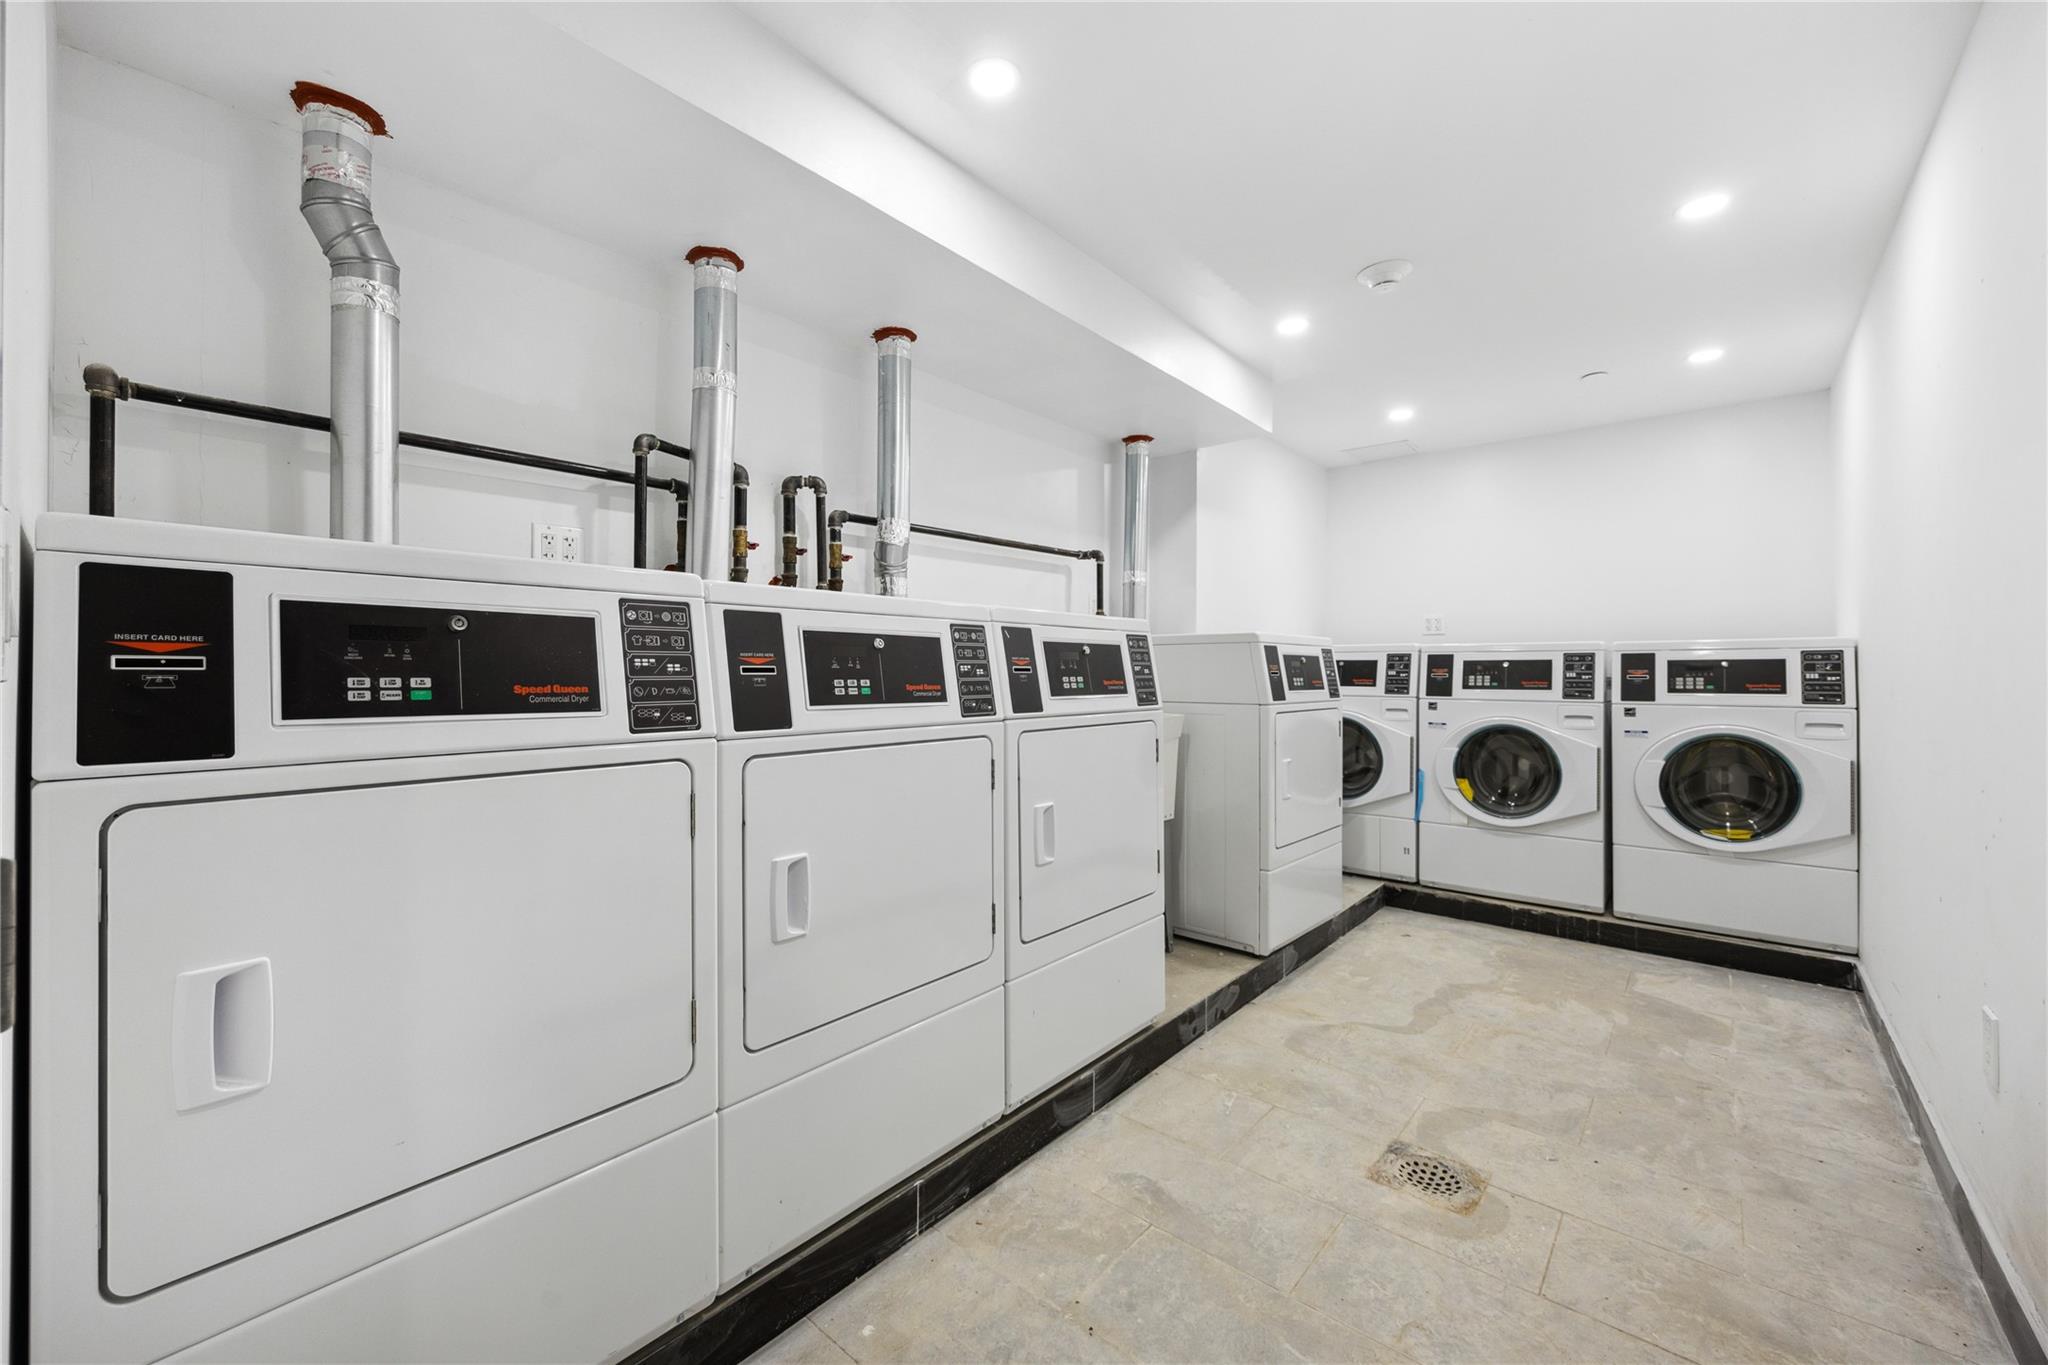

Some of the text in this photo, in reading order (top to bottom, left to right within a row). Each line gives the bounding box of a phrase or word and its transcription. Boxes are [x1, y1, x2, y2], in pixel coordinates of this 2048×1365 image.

[114, 633, 149, 641] INSERT
[513, 684, 589, 696] Speed Queen
[529, 695, 589, 704] Commercial Dryer
